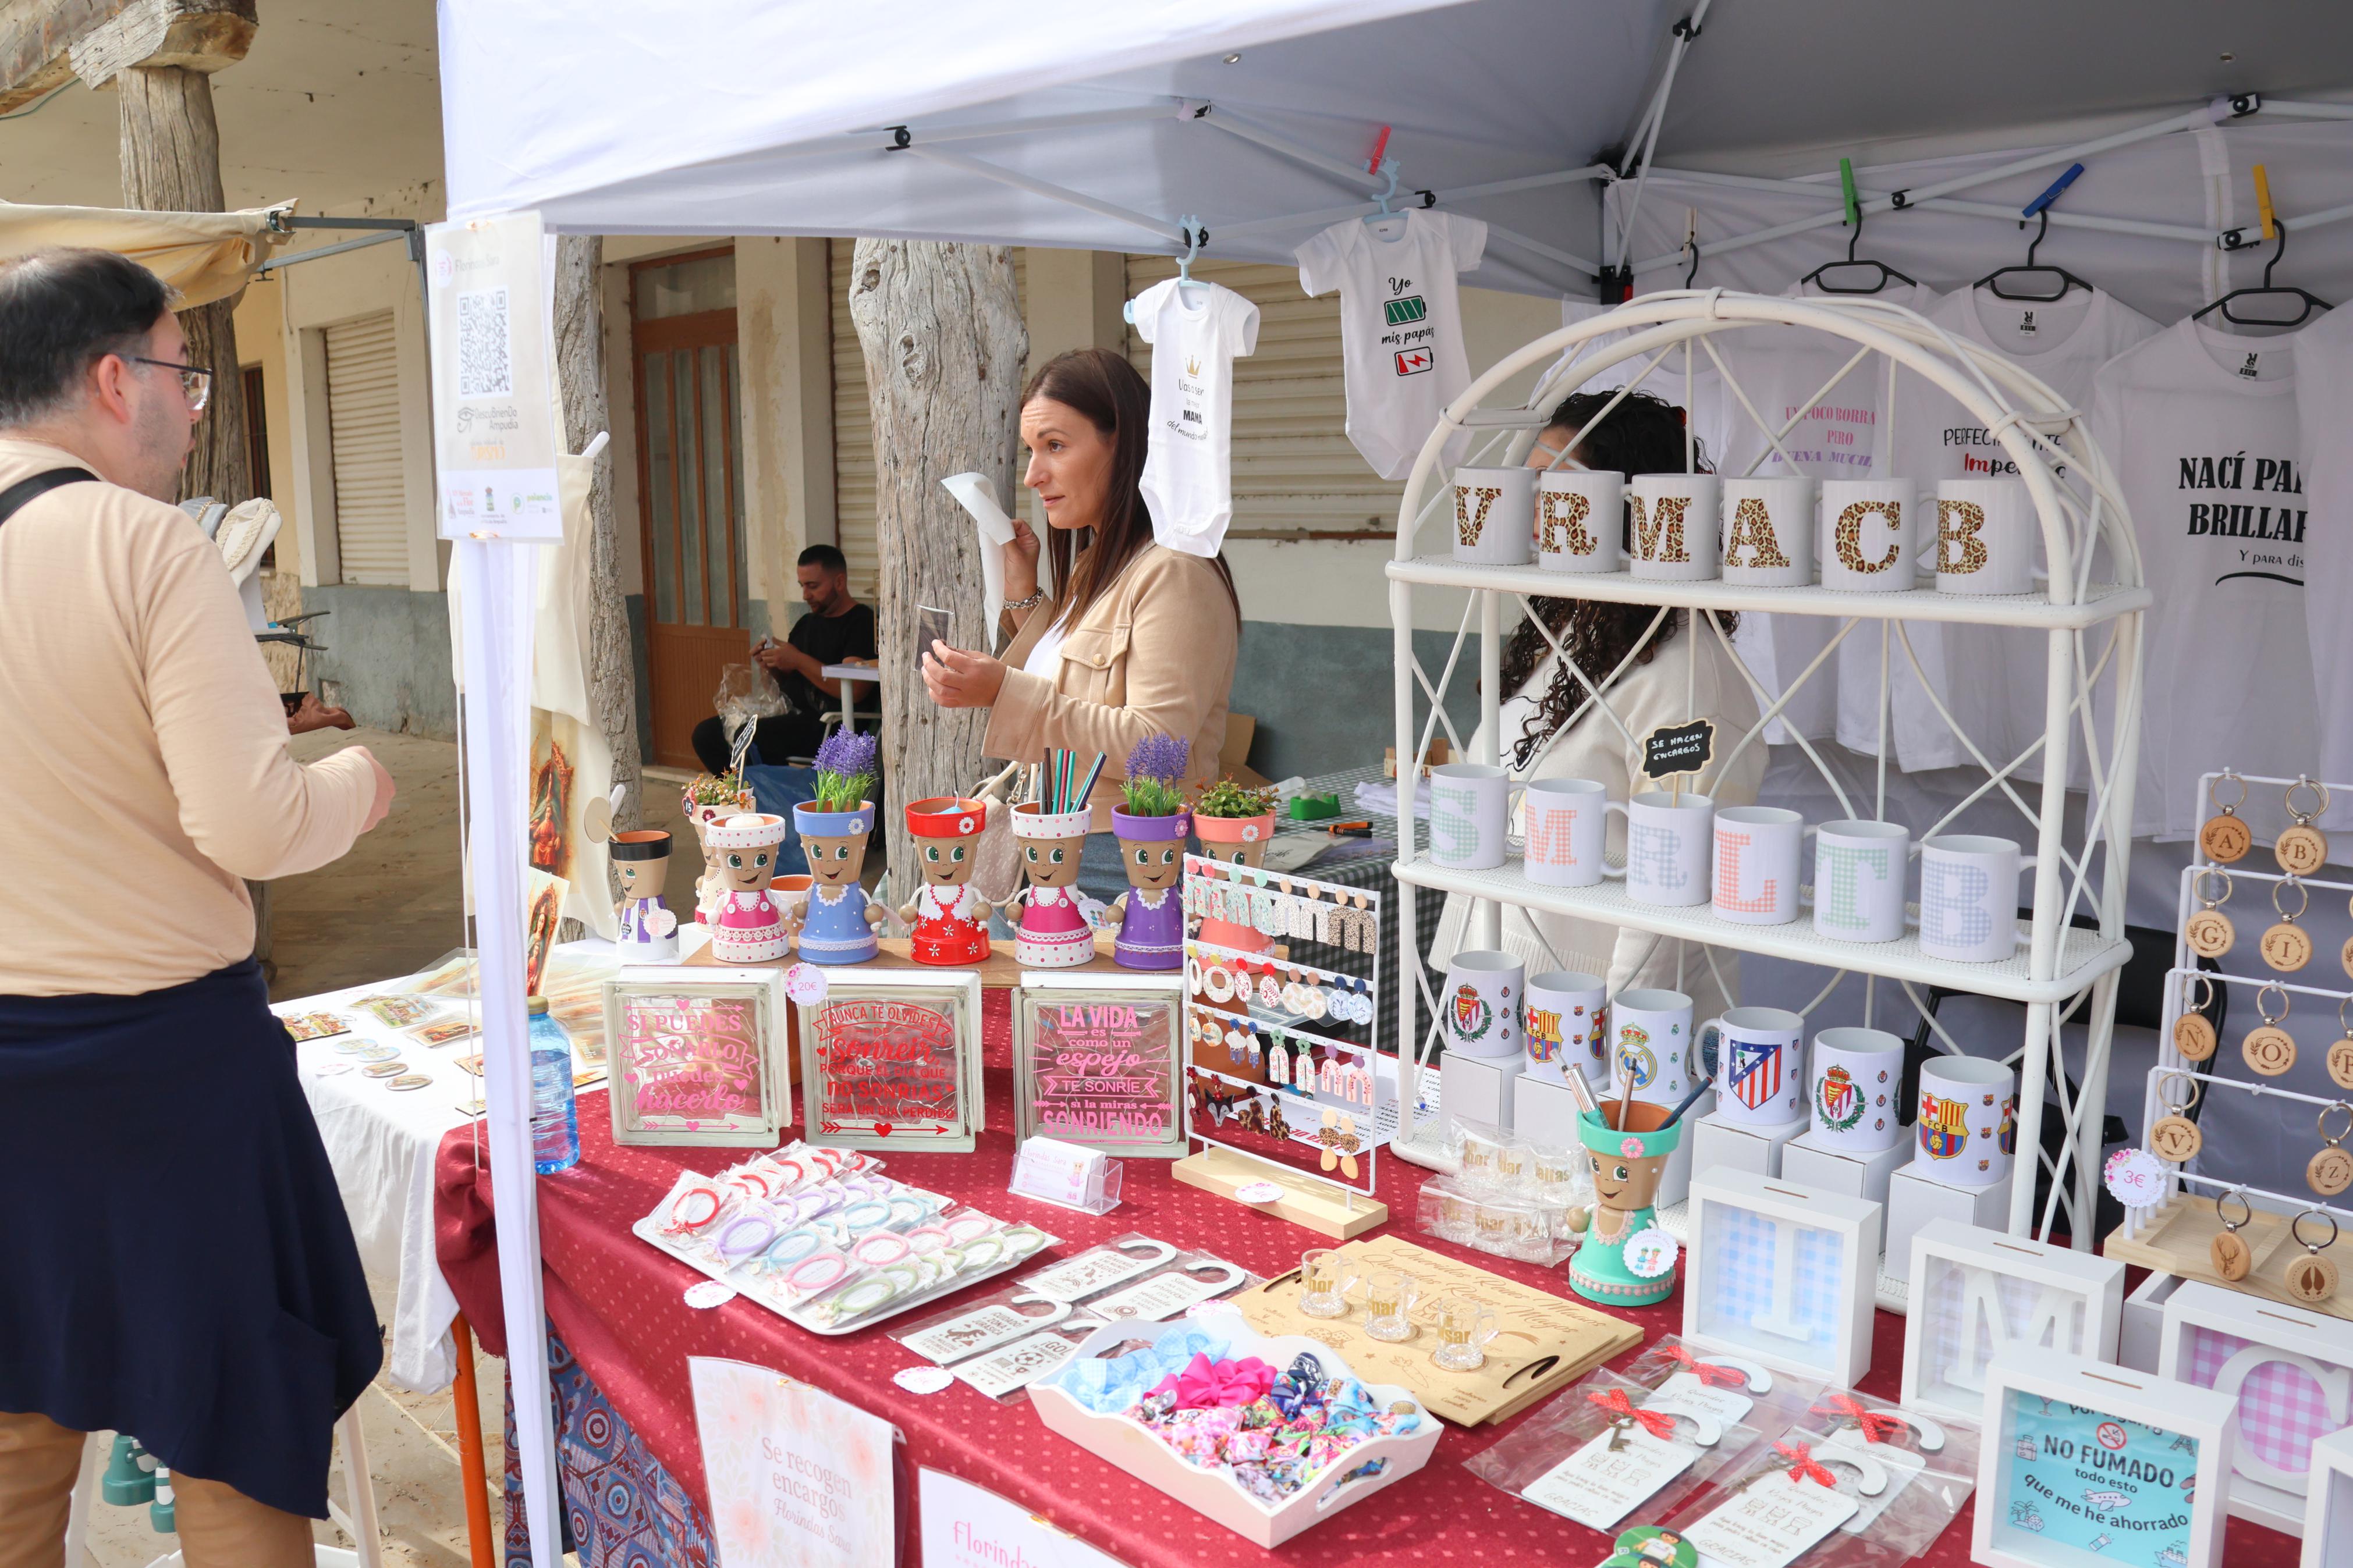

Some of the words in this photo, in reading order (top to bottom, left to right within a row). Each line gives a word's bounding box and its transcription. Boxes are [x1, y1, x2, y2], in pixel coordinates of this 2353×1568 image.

[1389, 277, 1413, 296] Yo
[1381, 332, 1402, 344] mis
[1404, 326, 1435, 345] papás
[1178, 379, 1191, 392] Vas
[1195, 386, 1204, 396] ser
[489, 419, 519, 433] Ampudia
[1183, 410, 1202, 424] MAMÁ
[1167, 419, 1179, 431] del
[1178, 428, 1197, 441] mundo
[1827, 430, 1854, 446] PERO
[2178, 451, 2245, 489] NACÍ
[1455, 485, 1502, 547] V
[1541, 490, 1598, 557] R
[1631, 495, 1692, 564] M
[1724, 498, 1791, 568] A
[1834, 500, 1900, 574] C
[1936, 499, 1988, 574] B
[2239, 549, 2249, 561] Y
[1651, 739, 1665, 749] SE
[1653, 743, 1701, 760] ENCARGOS
[685, 802, 693, 813] 15
[1431, 785, 1479, 862] S
[2218, 833, 2234, 850] A
[2294, 844, 2306, 859] B
[1712, 827, 1777, 913] L
[1815, 841, 1889, 931] T
[1921, 856, 1992, 948] B
[2201, 926, 2219, 944] G
[2281, 941, 2290, 958] I
[798, 982, 817, 991] 20€
[627, 1014, 647, 1031] SI
[654, 1014, 742, 1032] PUEDES
[828, 1007, 868, 1025] NUNCA
[871, 1006, 884, 1019] TE
[888, 1007, 936, 1030] OLVIDES
[1060, 1005, 1085, 1028] LA
[1088, 1005, 1138, 1029] VIDA
[873, 1027, 890, 1037] DE
[2185, 1031, 2200, 1048] N
[1069, 1040, 1109, 1048] como
[1112, 1040, 1131, 1048] un
[2261, 1044, 2282, 1062] O
[819, 1063, 872, 1076] PORQUE
[875, 1064, 892, 1076] EL
[920, 1068, 946, 1080] QUE
[1056, 1049, 1148, 1077] espejo
[652, 1066, 724, 1083] puedes
[1061, 1079, 1081, 1092] TE
[1084, 1079, 1141, 1094] SONRÍE
[633, 1083, 746, 1110] hacerlo
[1070, 1101, 1081, 1109] si
[1084, 1099, 1096, 1109] la
[1100, 1101, 1137, 1110] miras
[858, 1104, 874, 1115] UN
[902, 1106, 954, 1119] PERDIDO
[1043, 1110, 1163, 1137] SONRIENDO
[2168, 1132, 2185, 1149] V
[1023, 1147, 1050, 1162] Florindas
[2123, 1169, 2146, 1189] 3€
[2329, 1165, 2340, 1179] Z
[1391, 1248, 1472, 1279] Queridos
[1475, 1276, 1530, 1300] Reyes
[1358, 1254, 1442, 1285] Queridos
[1441, 1282, 1503, 1307] Reyes
[1504, 1304, 1579, 1334] Magos
[761, 1437, 783, 1464] Se
[786, 1448, 853, 1499] recogen
[2043, 1434, 2075, 1459] NO
[2081, 1444, 2174, 1488] FUMADO
[2075, 1467, 2106, 1484] todo
[2109, 1478, 2138, 1494] esto
[772, 1472, 847, 1523] encargos
[1543, 1492, 1599, 1517] GRACIAS
[2024, 1474, 2054, 1499] que
[2054, 1495, 2082, 1514] me
[2084, 1506, 2106, 1524] he
[2110, 1513, 2189, 1531] ahorrado
[773, 1498, 826, 1540] Florindas
[827, 1529, 854, 1556] Sara
[1698, 1538, 1757, 1567] GRACIAS
